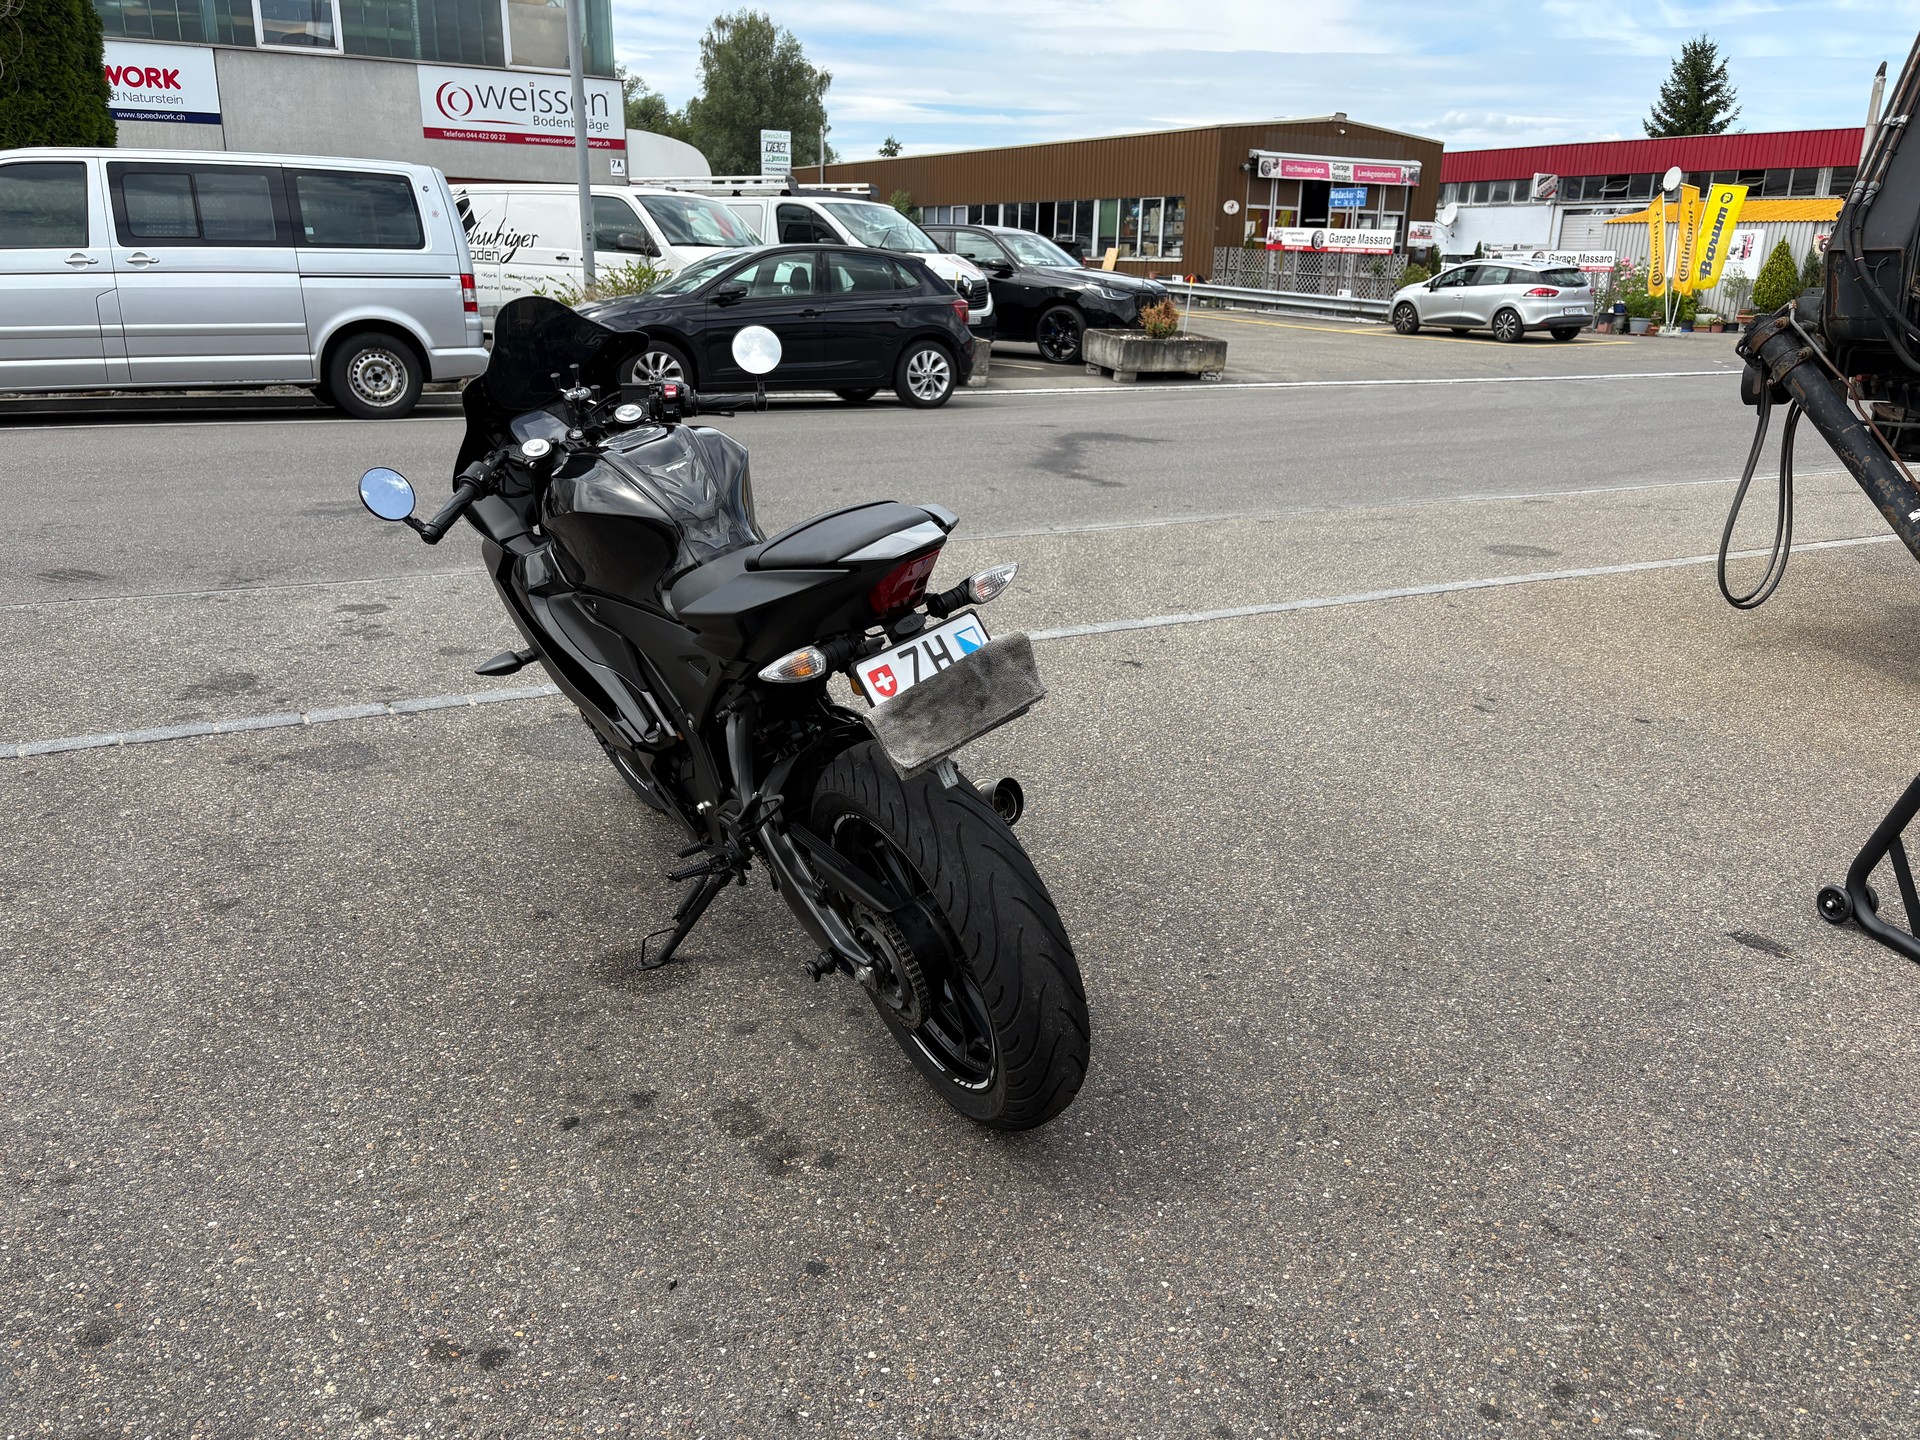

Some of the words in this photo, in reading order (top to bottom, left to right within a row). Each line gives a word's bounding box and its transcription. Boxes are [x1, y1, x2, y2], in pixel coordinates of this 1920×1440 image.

[122, 91, 184, 105] Naturstein
[116, 111, 186, 121] www.speedwork.ch
[533, 115, 609, 133] Bodenbläge
[442, 130, 466, 138] Telefon
[466, 131, 478, 139] 044
[478, 132, 489, 140] 422
[490, 133, 498, 141] 00
[525, 136, 611, 148] www.weissen-bodlaege.ch
[465, 217, 540, 264] chubiger
[1328, 232, 1356, 246] Garage
[1357, 233, 1392, 245] Massaro
[1700, 206, 1728, 280] Barum
[469, 247, 500, 261] oden
[1548, 253, 1577, 265] Garage
[1580, 253, 1613, 263] Massaro
